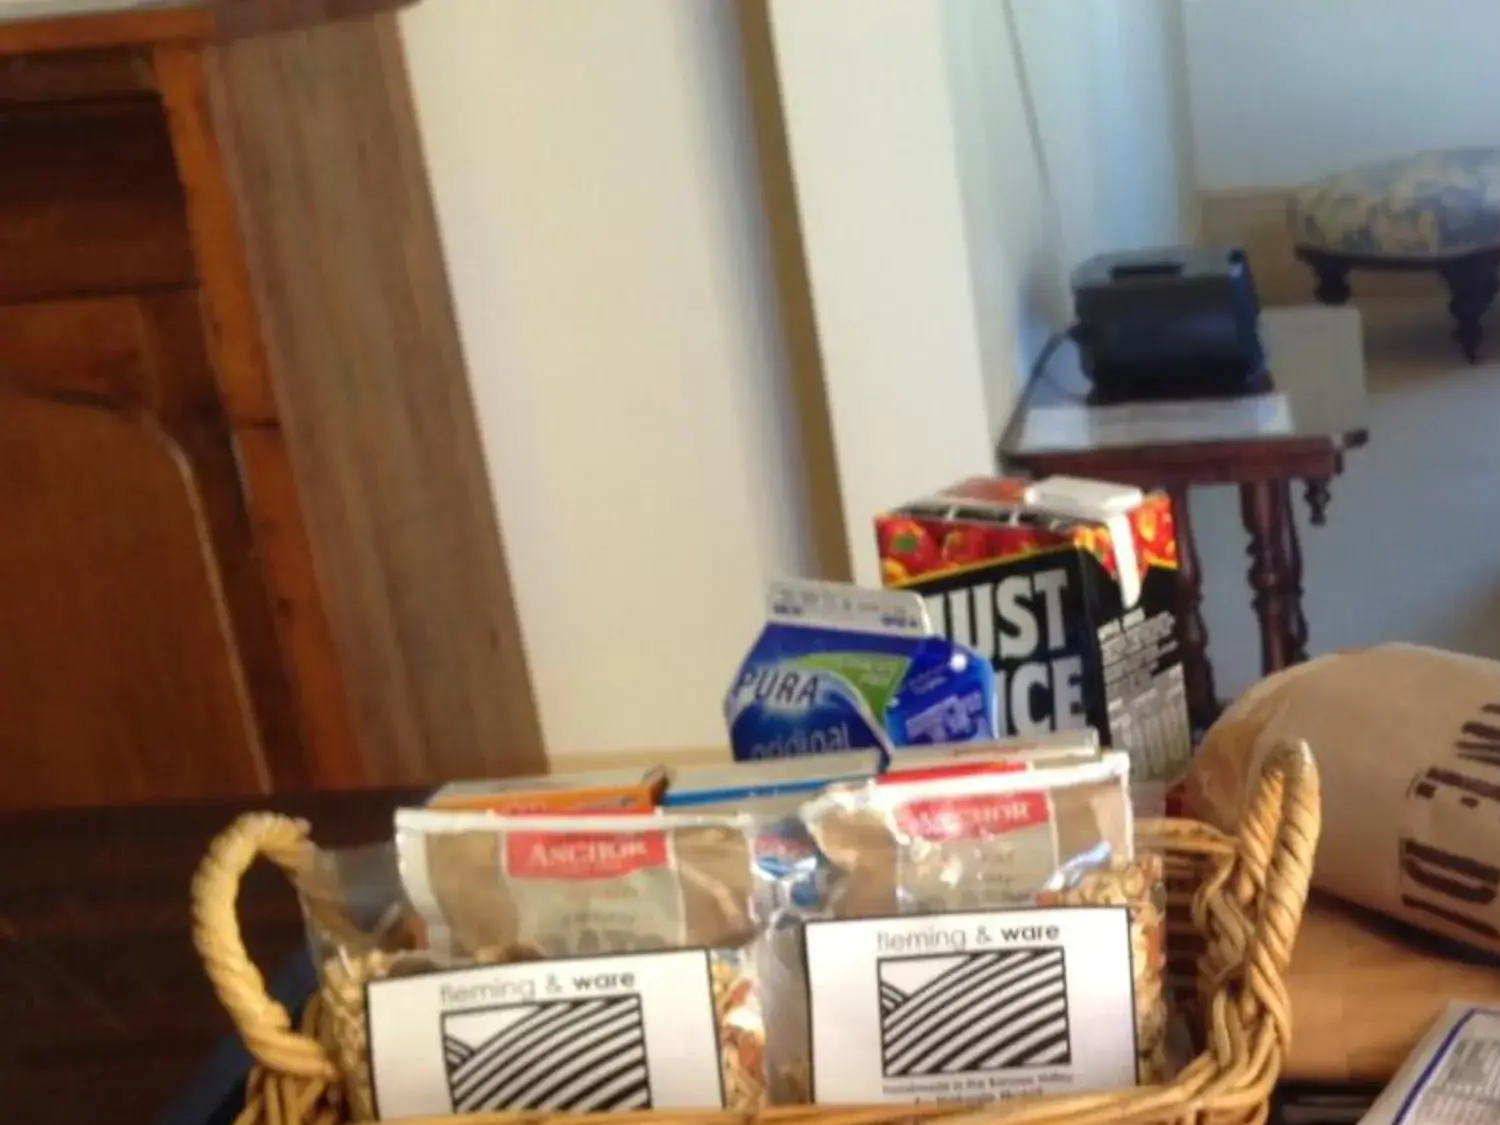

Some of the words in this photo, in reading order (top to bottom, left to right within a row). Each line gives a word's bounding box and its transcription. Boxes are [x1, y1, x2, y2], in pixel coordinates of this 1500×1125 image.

[730, 669, 819, 706] PURA
[876, 926, 968, 952] fleming
[976, 925, 994, 944] &
[999, 923, 1060, 943] ware
[439, 977, 538, 1004] fleming
[544, 972, 563, 993] &
[573, 970, 635, 992] ware
